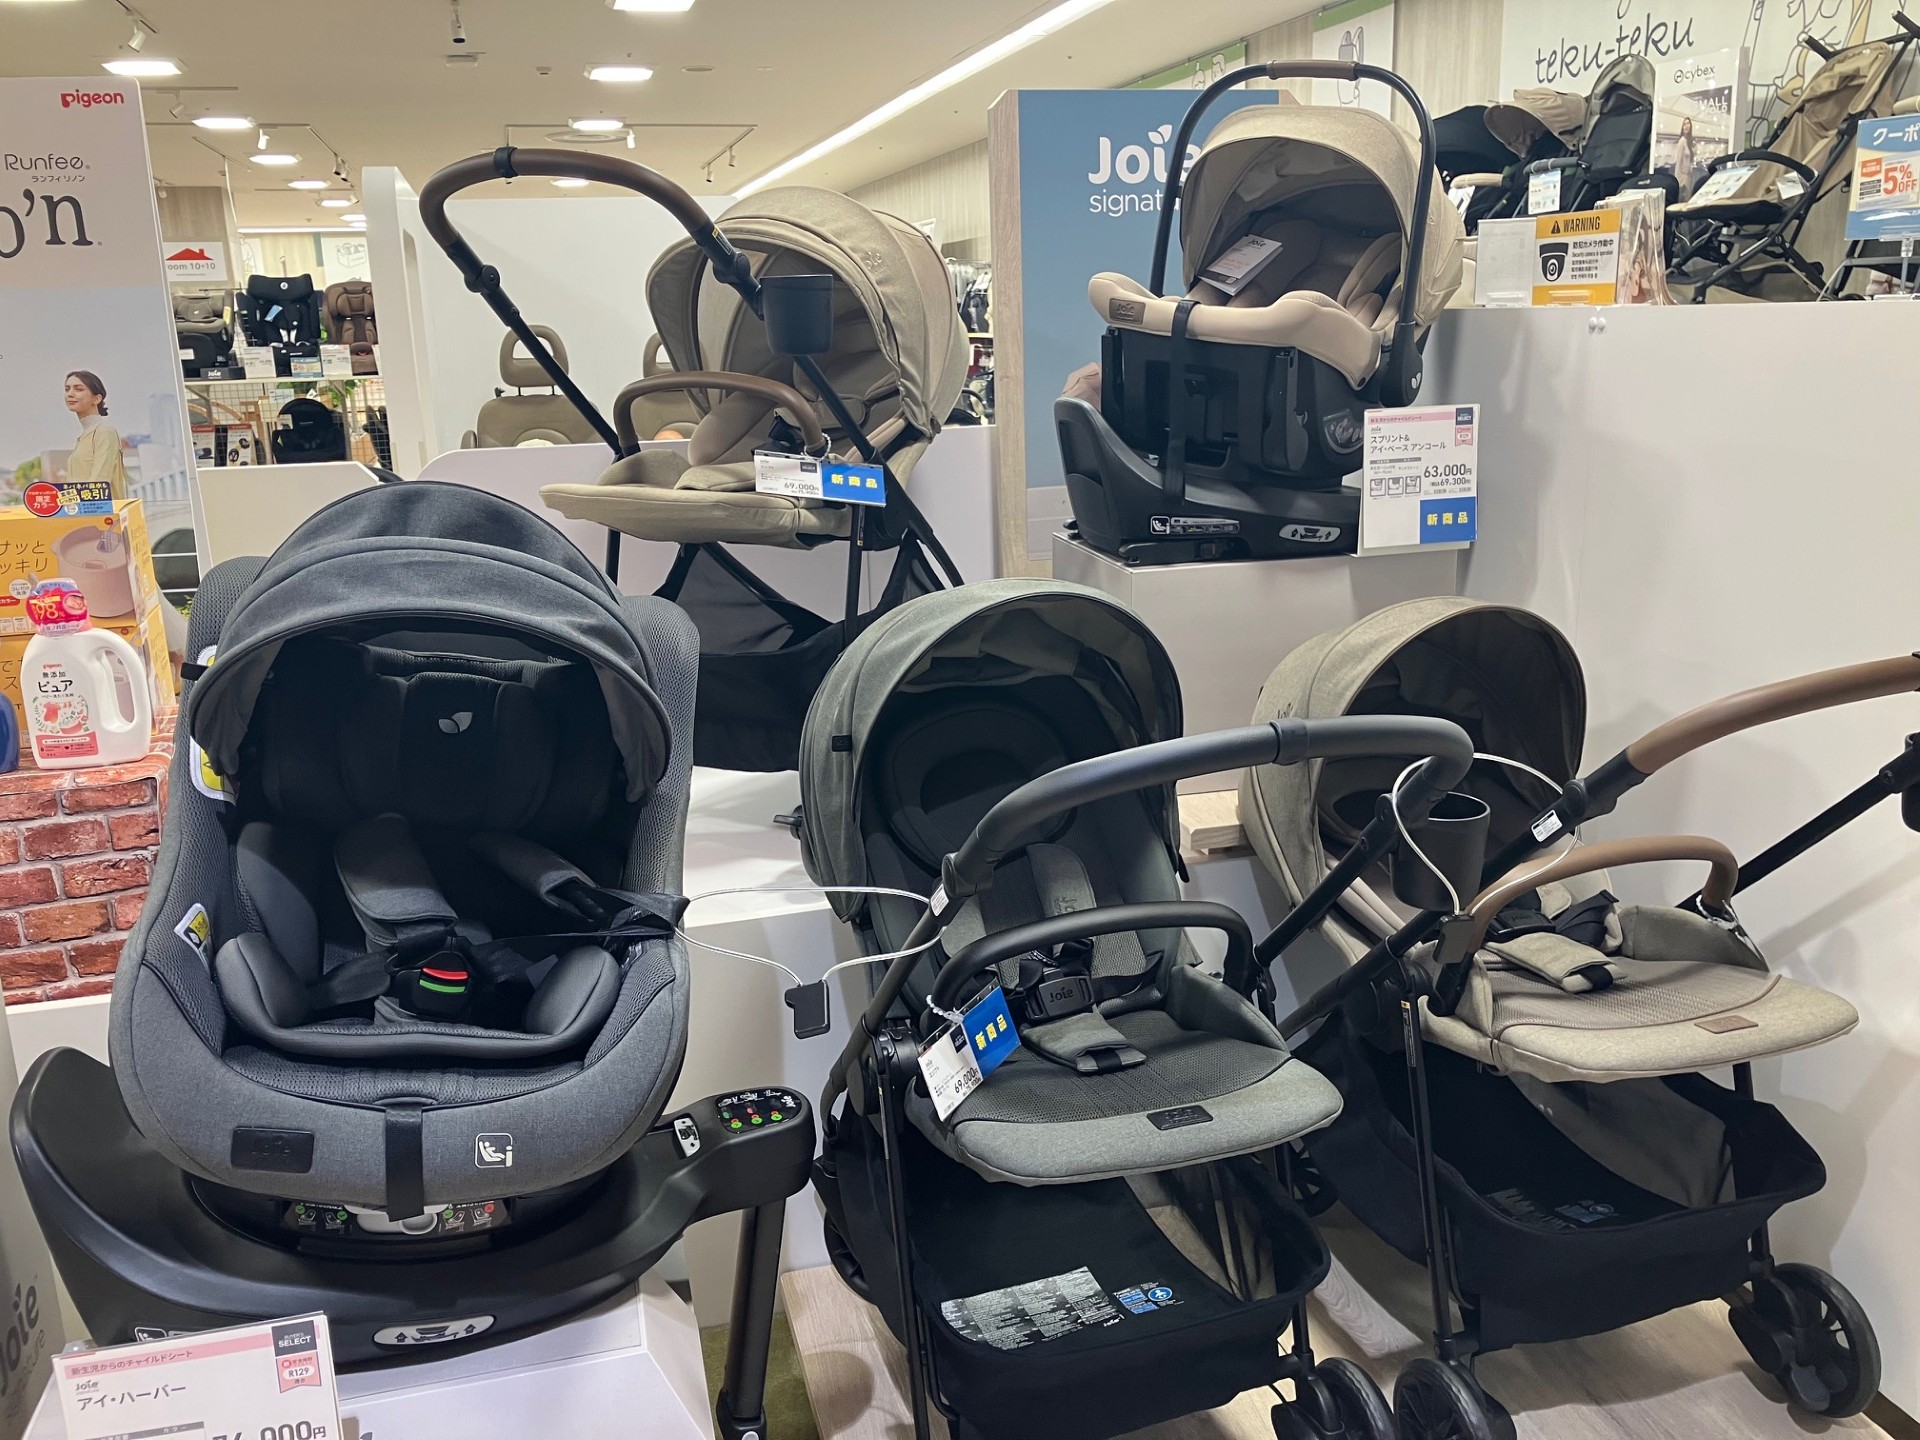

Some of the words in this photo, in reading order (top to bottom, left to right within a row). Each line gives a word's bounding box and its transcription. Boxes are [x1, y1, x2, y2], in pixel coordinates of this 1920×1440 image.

[1535, 13, 1694, 84] teku-teku
[1684, 65, 1715, 83] cybex
[60, 89, 125, 108] pigeon
[1873, 123, 1920, 146] クーポ
[1898, 180, 1918, 193] OFF
[1089, 189, 1180, 217] signat
[1563, 216, 1601, 233] WARNING
[1424, 464, 1472, 478] 63,000円
[1427, 512, 1468, 526] 新商品
[1049, 986, 1075, 1003] Joie
[278, 1336, 312, 1348] SELECT
[71, 1350, 193, 1376] 新生児からのチャイルドシート
[288, 1367, 309, 1378] R129
[75, 1379, 99, 1391] Joie
[77, 1384, 187, 1411] アイ・ハーバー
